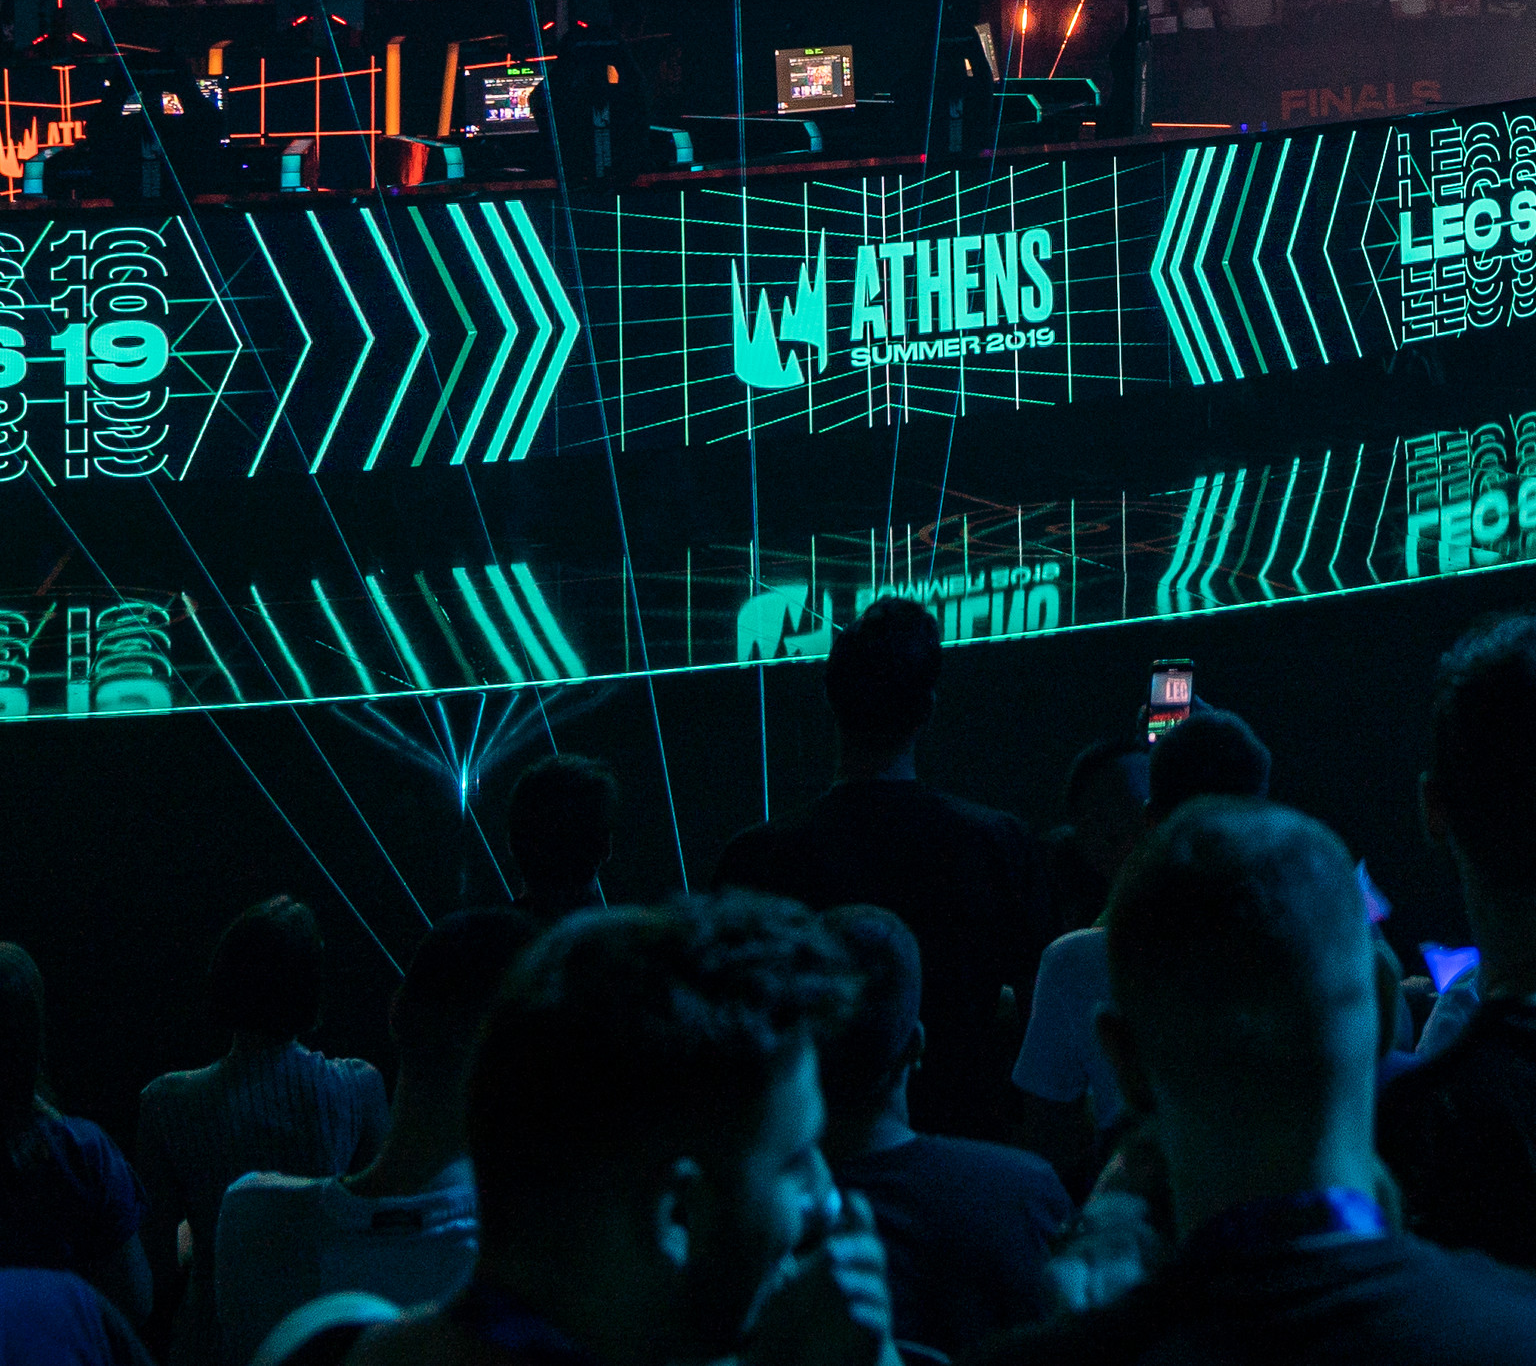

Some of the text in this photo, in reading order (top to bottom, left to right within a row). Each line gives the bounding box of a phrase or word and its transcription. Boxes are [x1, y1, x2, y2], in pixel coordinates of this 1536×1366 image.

[1280, 79, 1442, 121] FINALS
[1399, 197, 1502, 265] LEC
[850, 228, 1054, 342] ATHENS
[50, 320, 169, 386] 19
[850, 327, 1056, 367] SUMMER 2019
